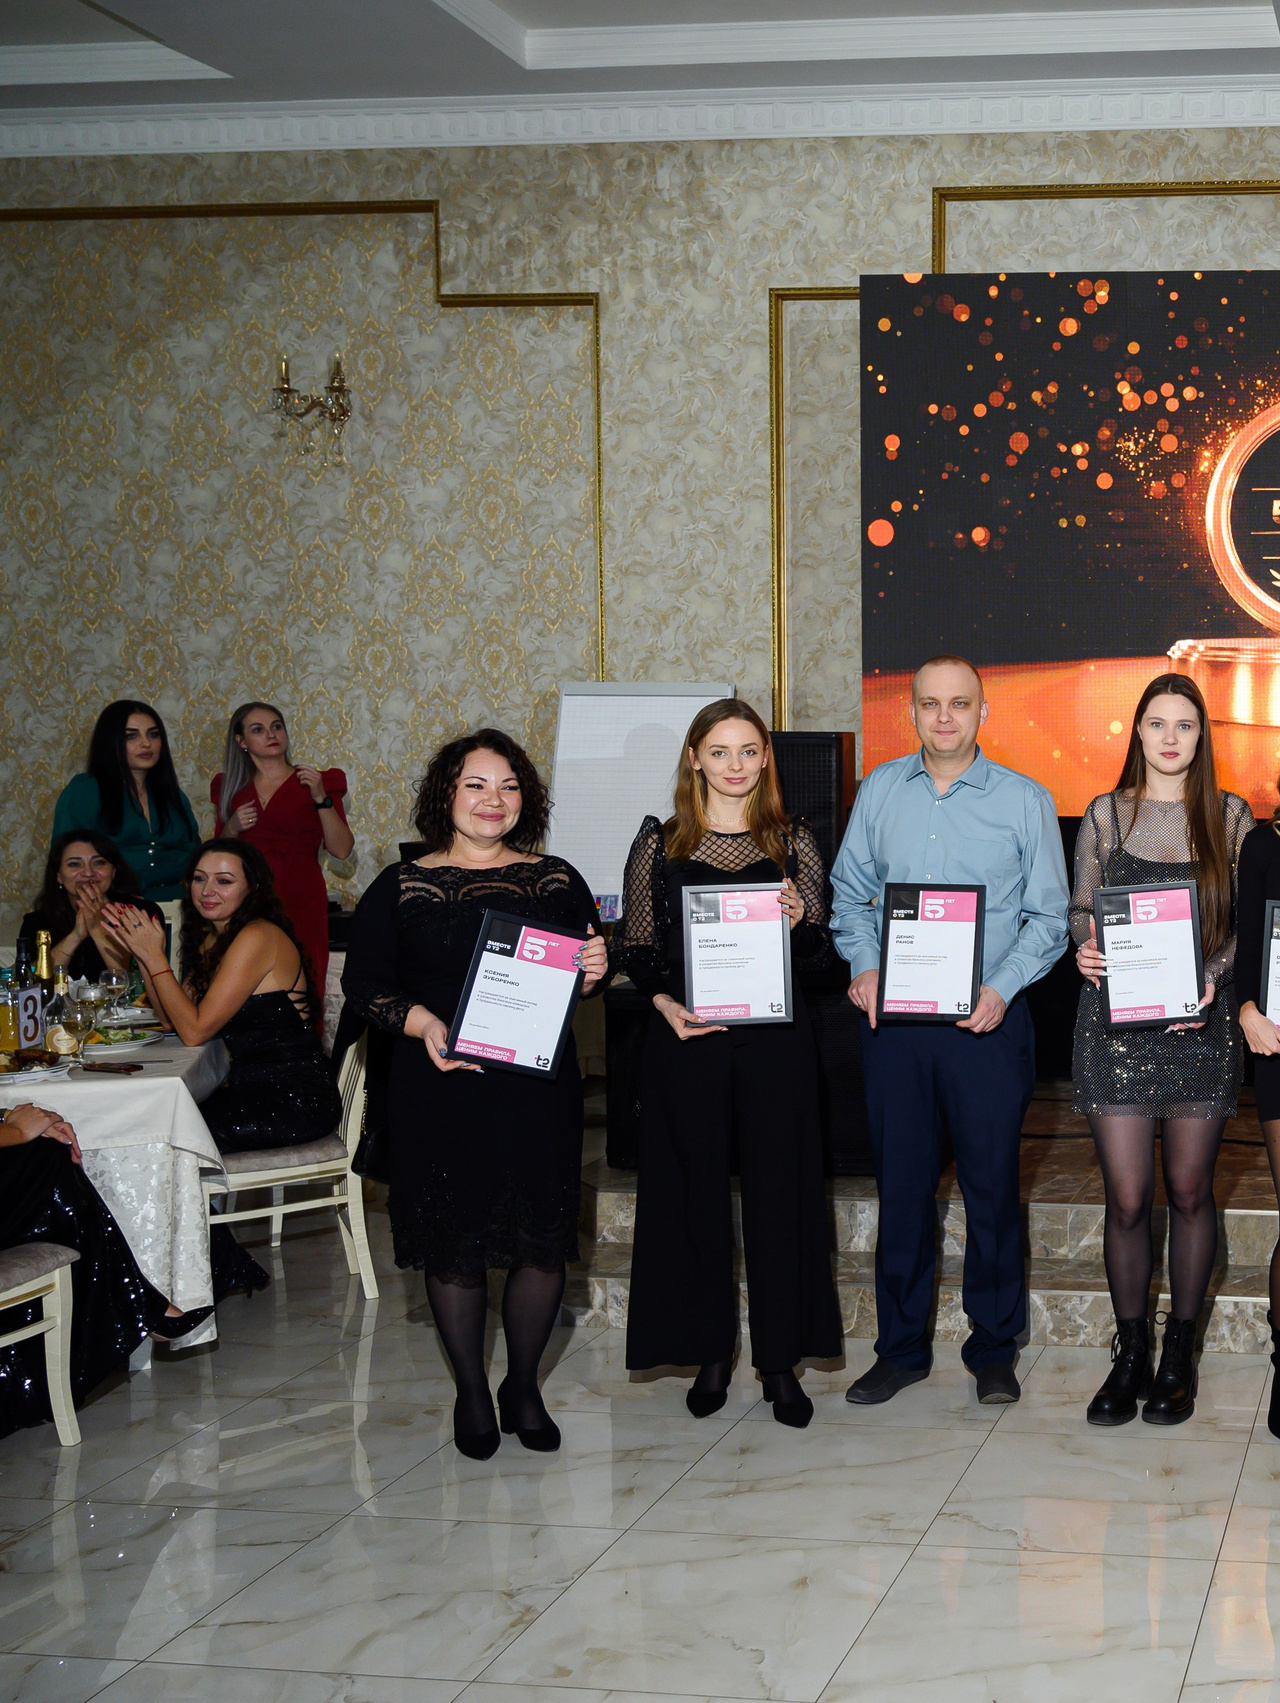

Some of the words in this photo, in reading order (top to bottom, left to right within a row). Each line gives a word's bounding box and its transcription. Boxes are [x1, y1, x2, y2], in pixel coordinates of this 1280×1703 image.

[726, 899, 748, 919] 5
[924, 899, 945, 918] 5
[1136, 899, 1157, 920] 5
[522, 936, 547, 960] 5
[484, 969, 509, 978] КСЕНИЯ
[23, 995, 38, 1042] 3
